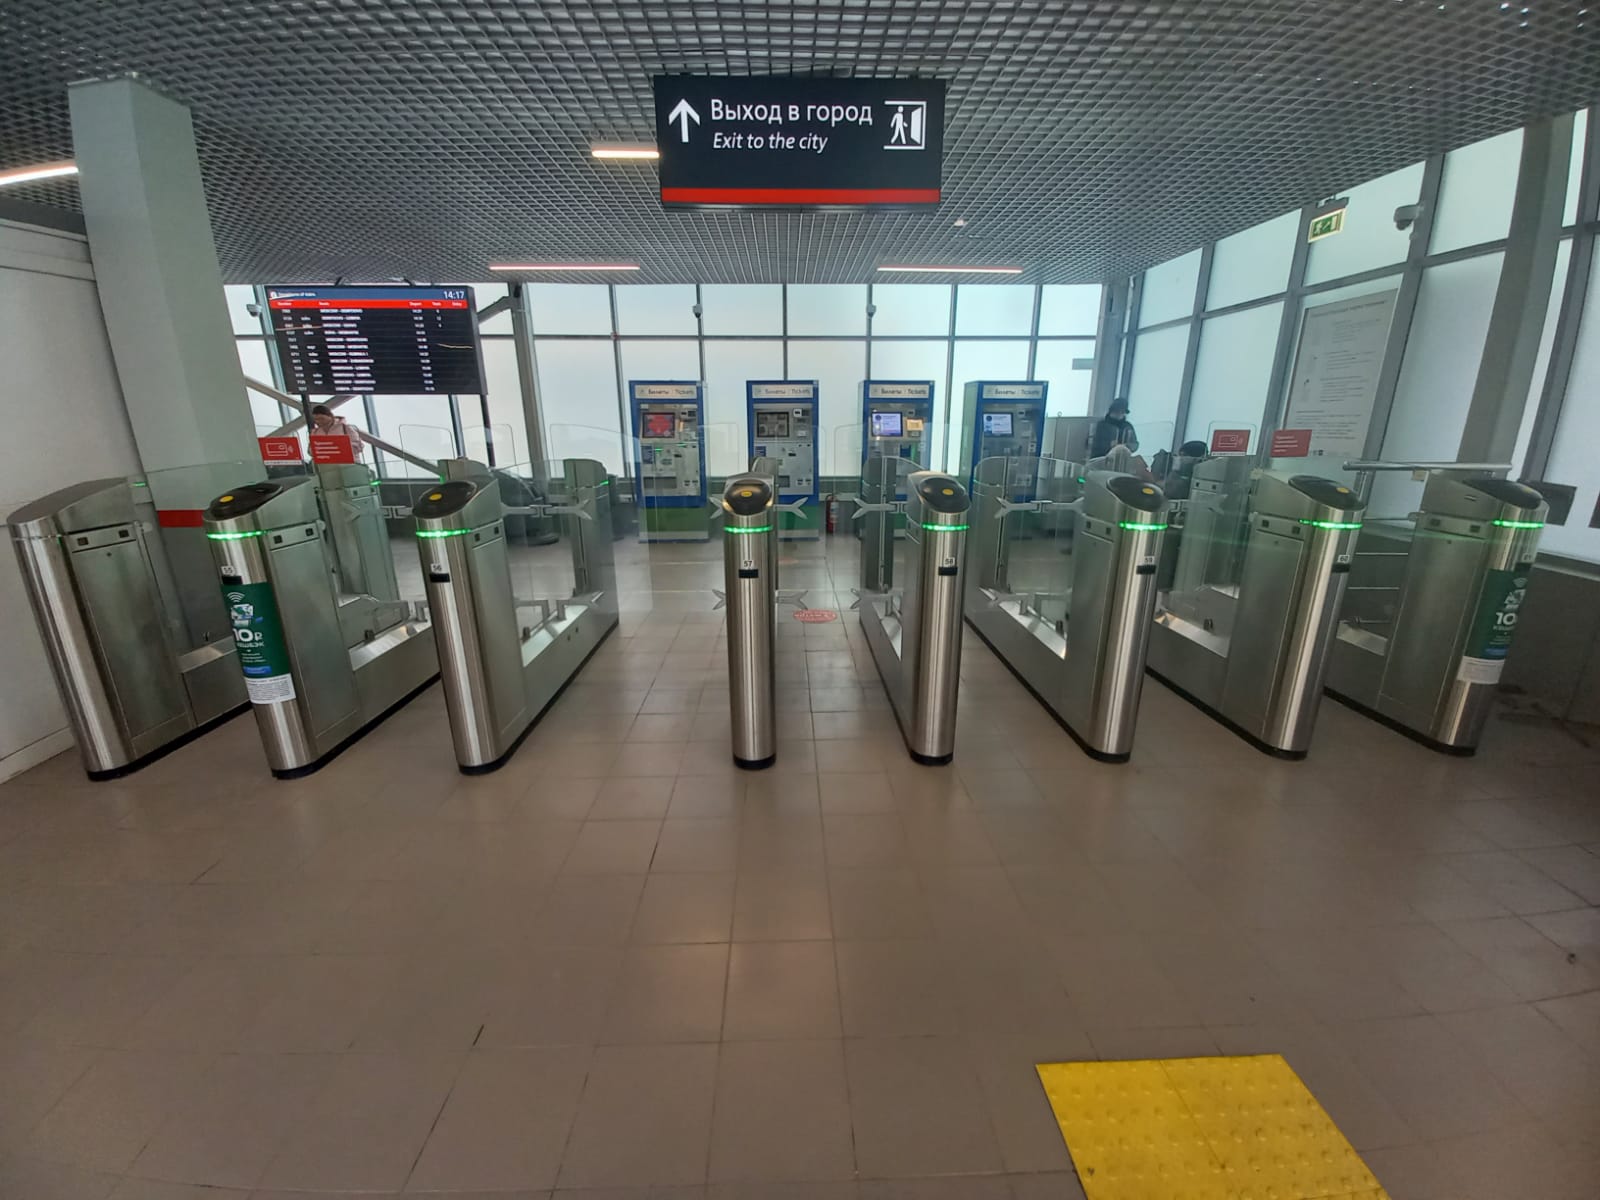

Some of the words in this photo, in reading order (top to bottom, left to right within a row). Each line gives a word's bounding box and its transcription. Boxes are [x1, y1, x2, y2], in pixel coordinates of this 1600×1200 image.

[711, 98, 782, 125] Выход
[788, 105, 800, 121] в
[807, 105, 873, 127] город
[713, 132, 743, 149] Exit
[746, 134, 764, 149] to
[768, 132, 795, 149] the
[799, 132, 828, 153] city
[443, 290, 464, 299] 14:17
[1496, 612, 1516, 626] 10
